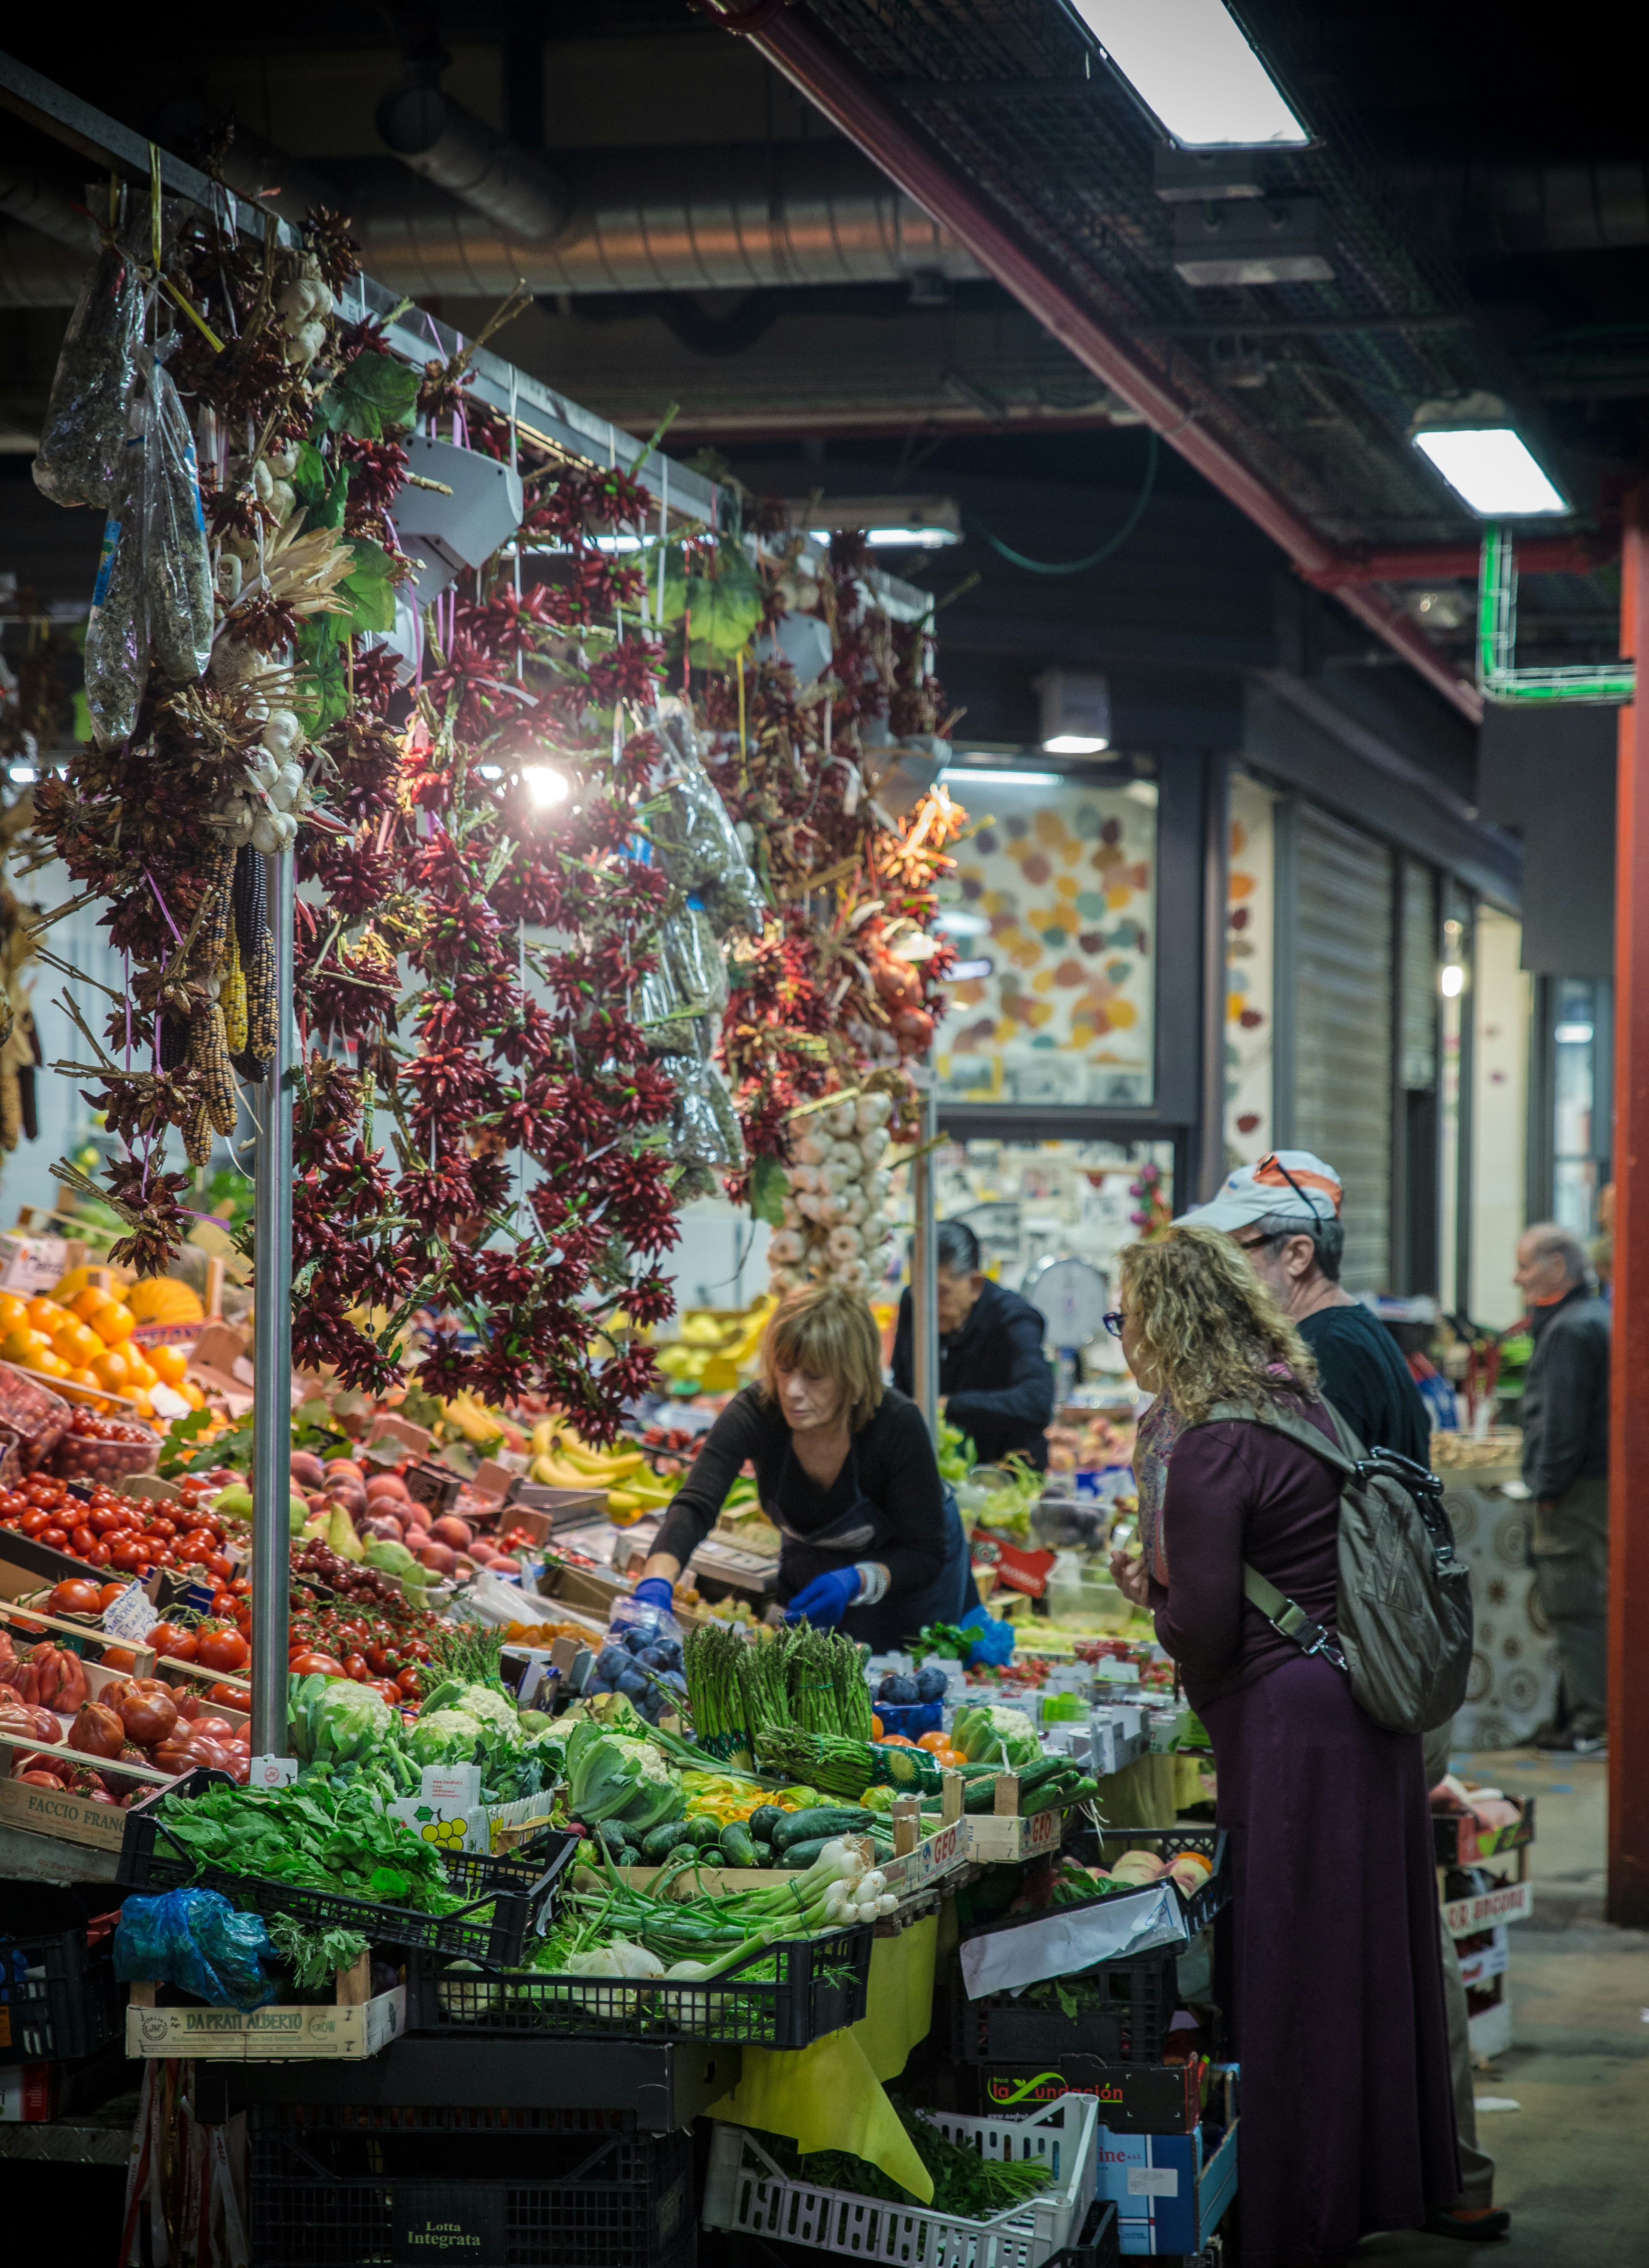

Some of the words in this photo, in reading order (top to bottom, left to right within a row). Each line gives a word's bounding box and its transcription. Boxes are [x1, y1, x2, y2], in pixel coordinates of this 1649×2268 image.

[28, 1796, 79, 1820] FACCIO
[1032, 1812, 1052, 1843] GEO
[934, 1828, 956, 1865] GEO
[246, 2013, 302, 2030] ALBERTO
[993, 2083, 1009, 2098] la
[426, 2221, 462, 2231] Lotta
[408, 2231, 481, 2249] Integrata
